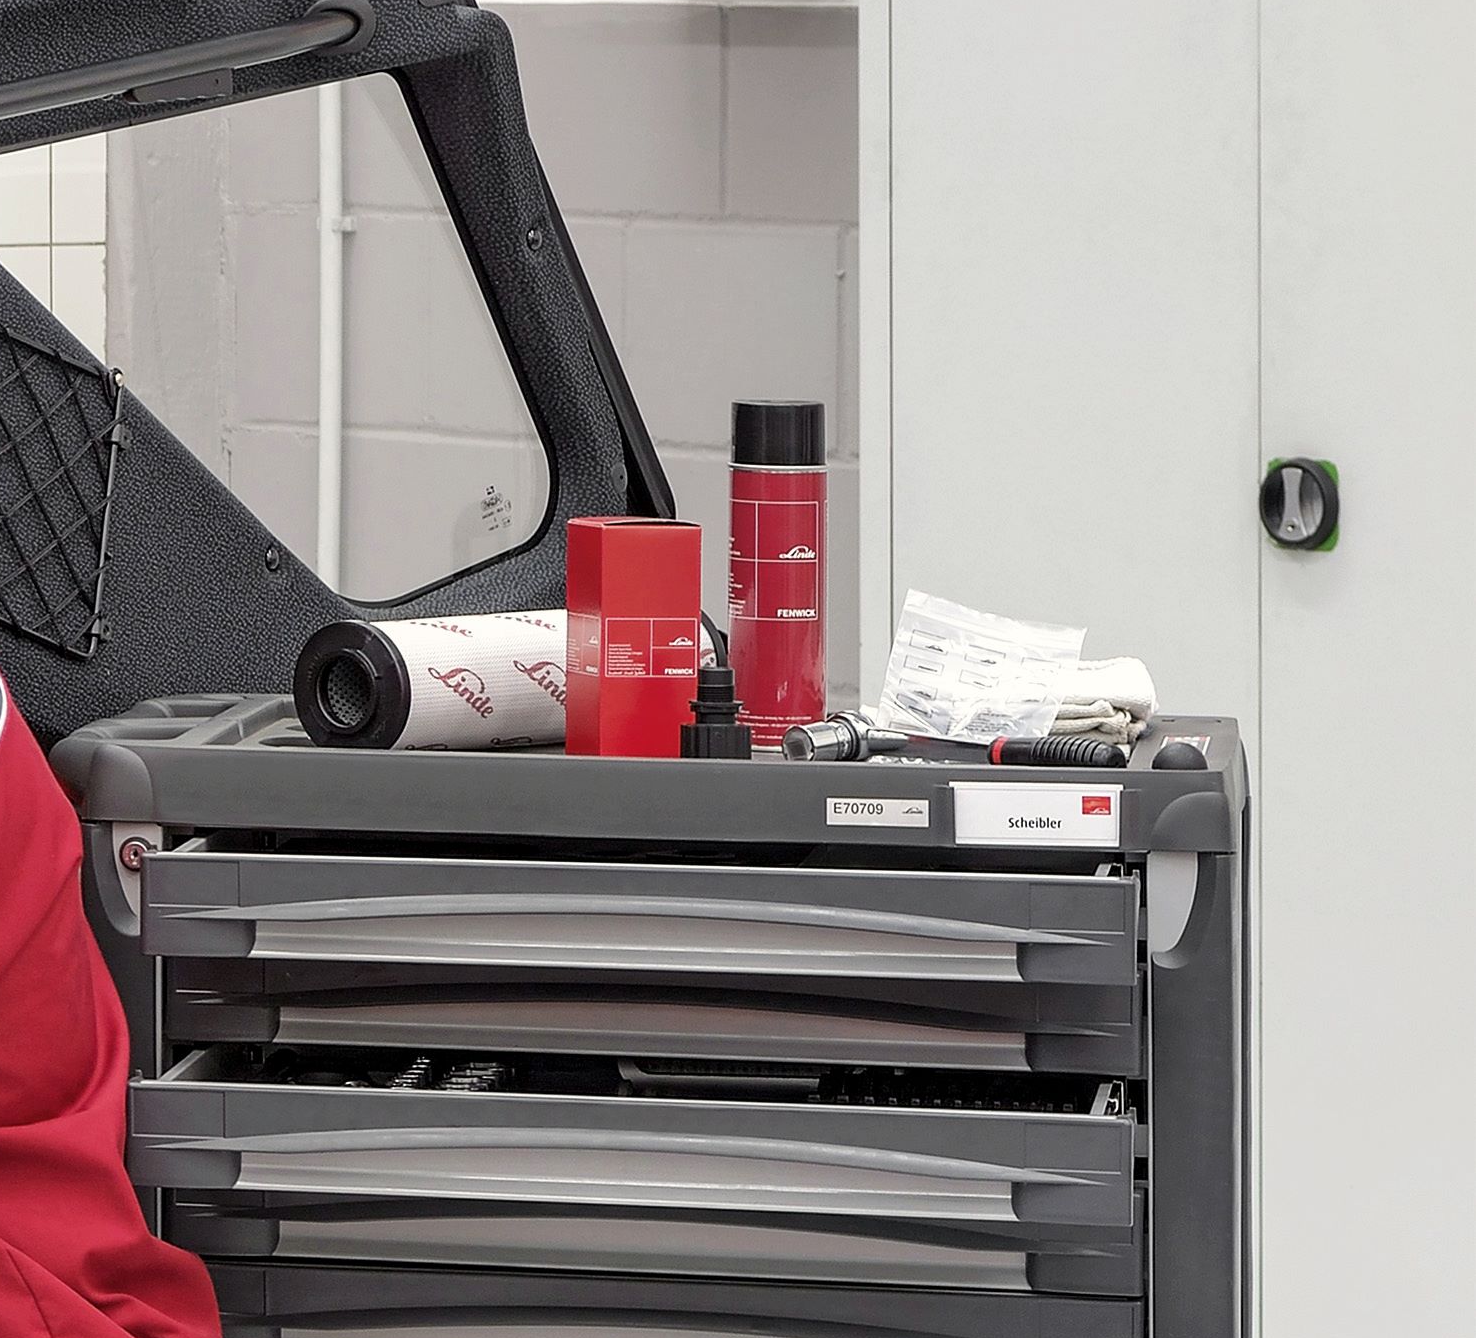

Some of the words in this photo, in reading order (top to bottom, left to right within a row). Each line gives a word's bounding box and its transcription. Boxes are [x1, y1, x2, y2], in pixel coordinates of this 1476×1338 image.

[778, 545, 816, 559] Linde
[776, 608, 816, 618] FENWICK
[427, 667, 494, 719] Linde
[832, 802, 884, 816] E70709
[1007, 816, 1063, 830] Scheibler
